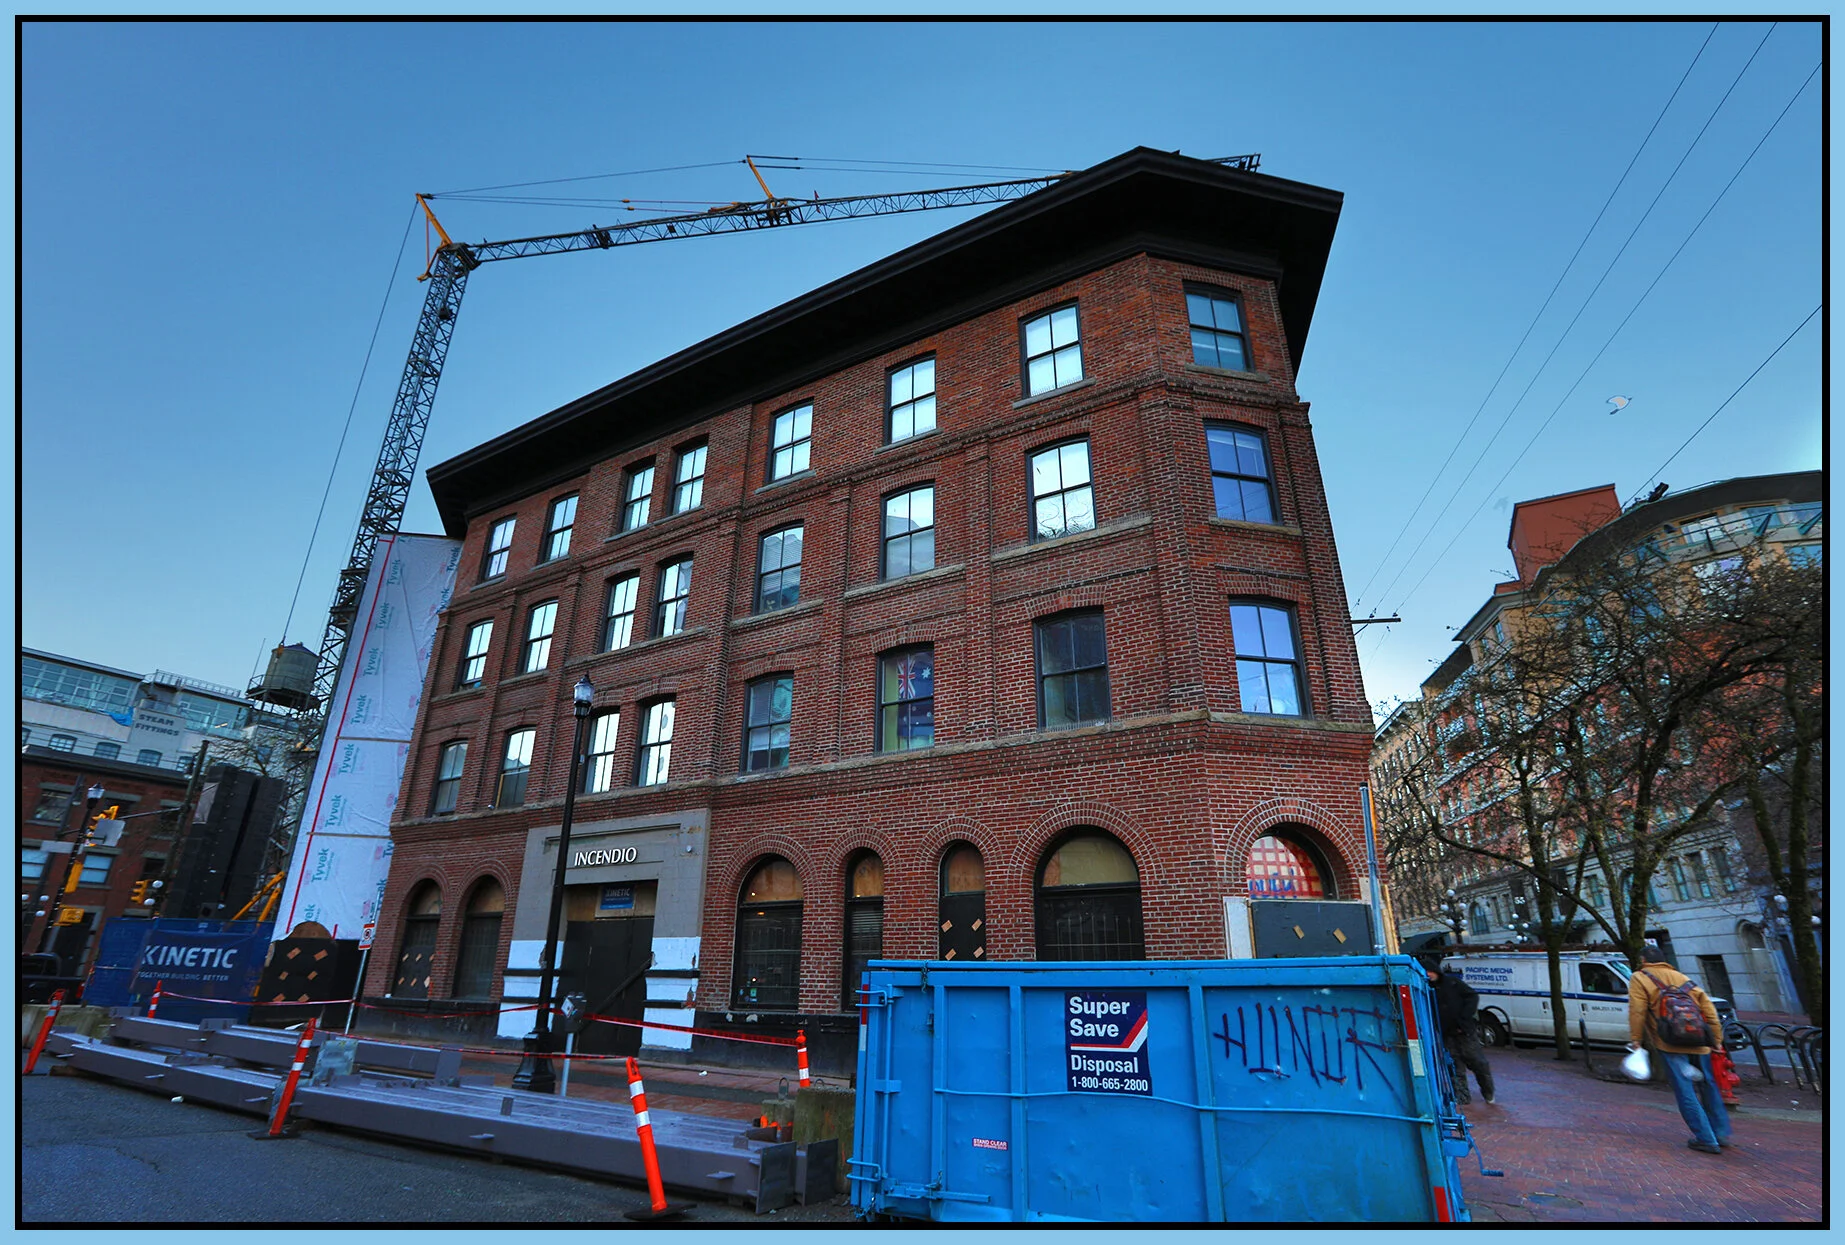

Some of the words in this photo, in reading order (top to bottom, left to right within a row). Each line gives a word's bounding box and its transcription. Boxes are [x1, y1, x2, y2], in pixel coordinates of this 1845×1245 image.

[446, 547, 460, 572] Tyvek
[387, 559, 401, 585] Tyvek
[375, 602, 389, 630] Tyvek
[363, 648, 379, 676] Tyvek
[139, 714, 174, 726] STEAM
[351, 694, 367, 724] Tyvek
[135, 723, 179, 736] FITTINGS
[338, 743, 354, 774] Tyvek
[325, 795, 342, 827] Tyvek
[311, 848, 330, 882] Tyvek
[574, 847, 637, 866] INCENDIO
[141, 945, 239, 969] KINETIC
[1069, 996, 1130, 1019] Super
[1069, 1018, 1119, 1037] Save
[1070, 1054, 1139, 1076] Disposal
[1071, 1076, 1149, 1091] 1-800-665-2800
